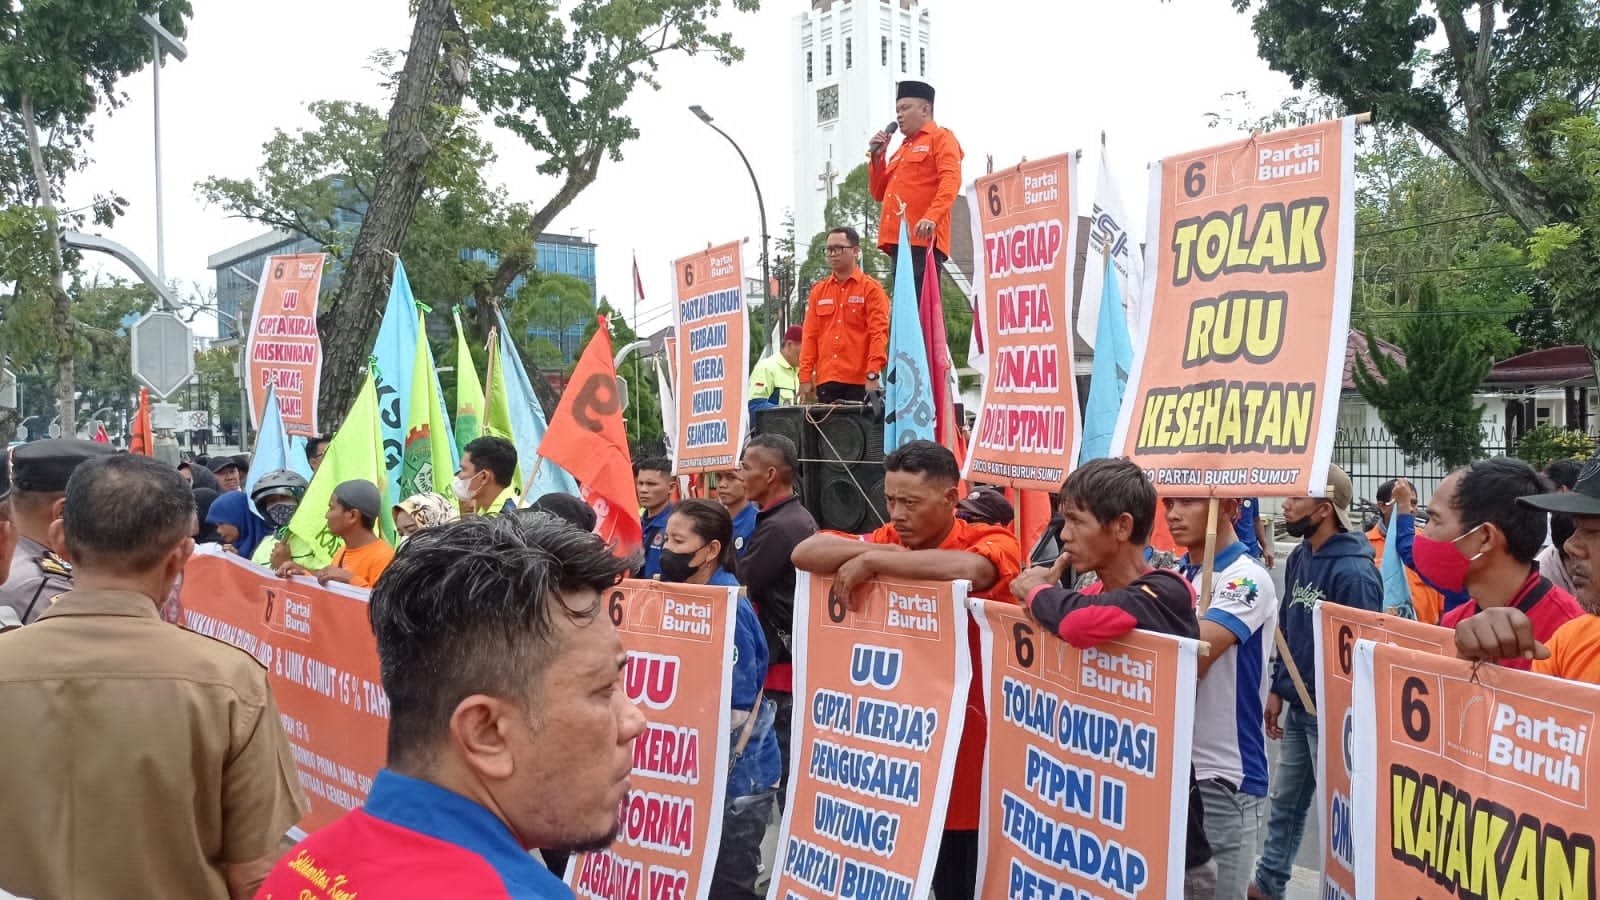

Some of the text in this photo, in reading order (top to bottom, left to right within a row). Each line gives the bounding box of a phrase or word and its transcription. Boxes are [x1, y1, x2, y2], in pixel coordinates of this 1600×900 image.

[1258, 138, 1320, 165] Partai
[1258, 156, 1320, 181] Buruh
[1023, 171, 1057, 190] Partai
[1024, 187, 1058, 204] Buruh
[1183, 161, 1206, 198] 6
[987, 183, 1002, 217] 6
[1174, 200, 1327, 284] TOLAK
[274, 262, 284, 280] 6
[684, 263, 694, 287] 6
[283, 291, 298, 309] UU
[680, 288, 740, 323] PARTAI BURUH
[998, 287, 1052, 331] MAFIA
[258, 316, 287, 335] CIPTA
[1184, 294, 1285, 366] RUU
[995, 348, 1057, 389] TANAH
[276, 396, 301, 416] LAK!!
[1137, 382, 1313, 451] KESEHATAN
[1007, 409, 1051, 449] PTPN
[1052, 411, 1065, 450] II
[1011, 465, 1036, 479] BURUH
[1038, 467, 1064, 481] SUMUT
[1157, 469, 1201, 485] PARTAI
[1205, 469, 1247, 485] BURUH
[1250, 468, 1299, 485] SUMUT
[285, 597, 310, 617] Partai
[608, 590, 624, 627] 6
[664, 599, 711, 619] Partai
[887, 591, 937, 613] Partai
[887, 609, 938, 633] Buruh
[662, 616, 711, 636] Buruh
[1012, 622, 1034, 668] 6
[284, 648, 306, 685] UMK
[306, 660, 337, 700] SUMUT
[338, 671, 350, 706] 15
[625, 655, 676, 704] UU
[851, 646, 900, 687] UU
[1083, 648, 1153, 680] Partai
[1081, 668, 1152, 704] Buruh
[812, 691, 937, 748] CIPTA KERJA?
[1003, 680, 1157, 775] TOLAK OKUPASI
[1400, 676, 1432, 743] 6
[1493, 702, 1587, 756] Partai
[632, 727, 698, 779] KERJA
[809, 741, 920, 803] PENGUSAHA
[1488, 733, 1581, 792] Buruh
[1026, 748, 1124, 826] PTPN II
[619, 795, 693, 850] FORMA
[814, 794, 898, 854] UNTUNG!
[1391, 768, 1594, 900] KATAKAN
[1002, 793, 1147, 895] TERHADAP
[650, 870, 686, 900] YES
[784, 838, 840, 893] PARTAI
[1009, 861, 1103, 900] PET
